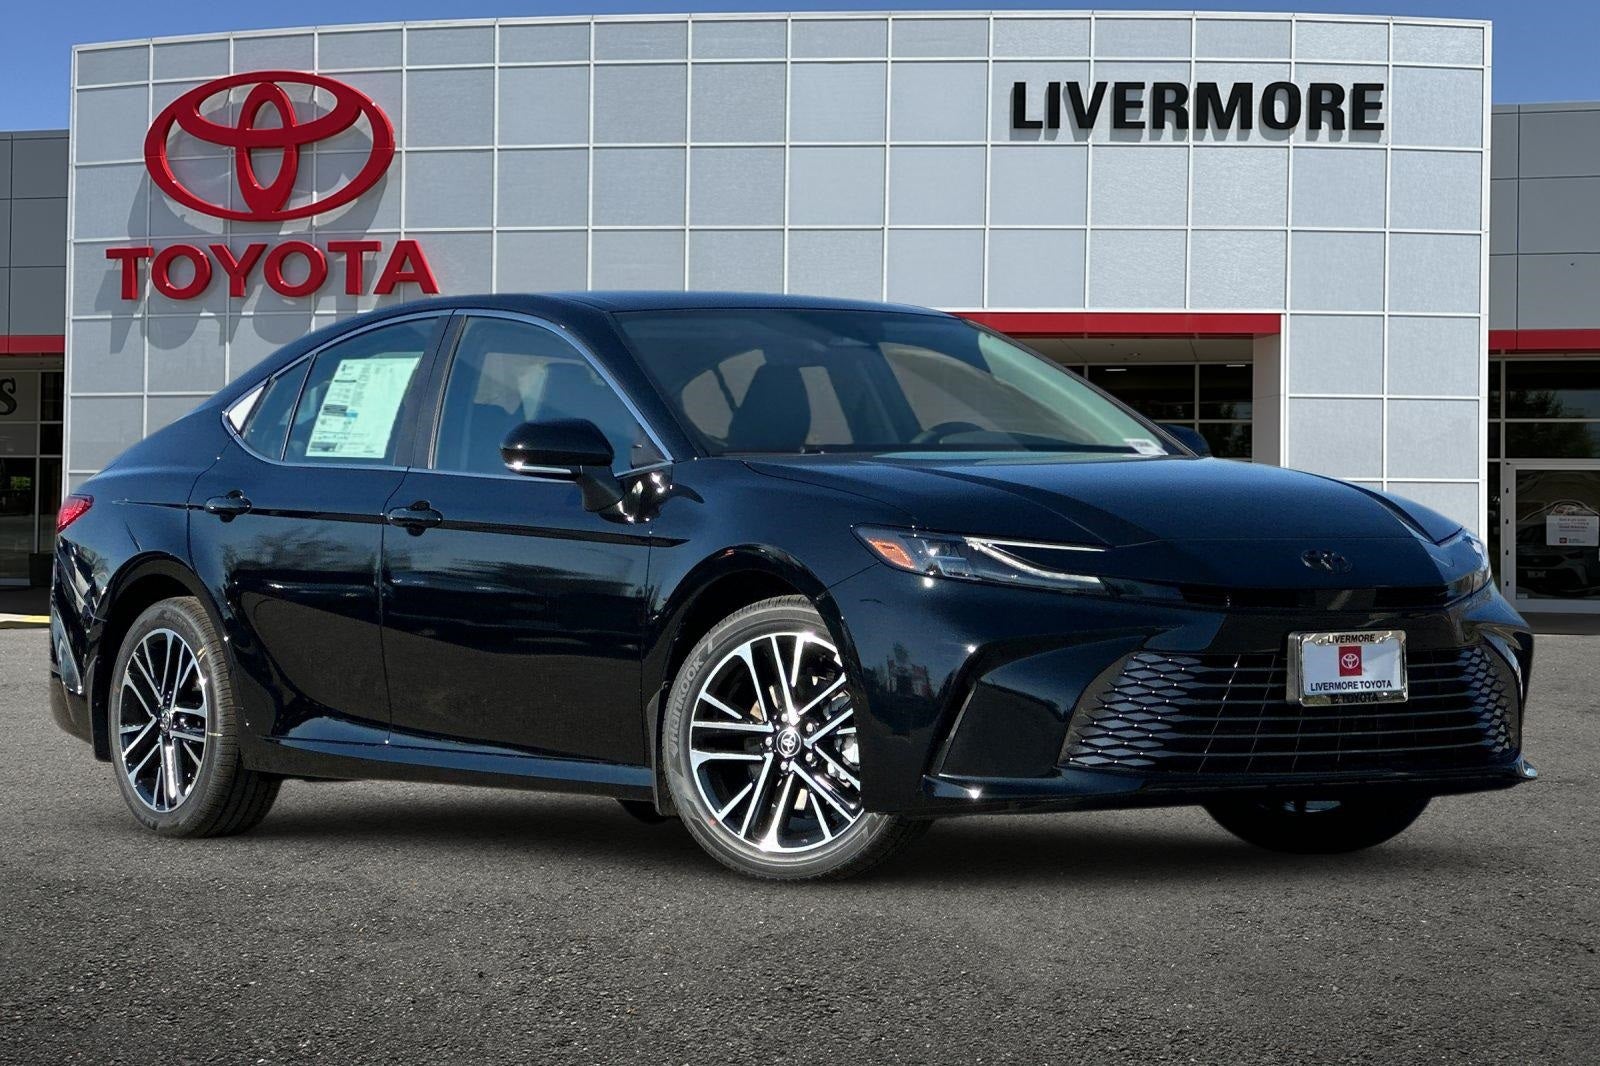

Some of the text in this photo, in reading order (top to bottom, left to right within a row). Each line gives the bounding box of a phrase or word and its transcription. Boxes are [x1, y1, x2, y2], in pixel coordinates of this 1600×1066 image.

[1012, 81, 1385, 131] LIVERMORE
[105, 240, 440, 300] TOYOTA
[1327, 634, 1375, 644] LIVERMORE
[1310, 680, 1392, 692] LIVERMORE TOYOTA
